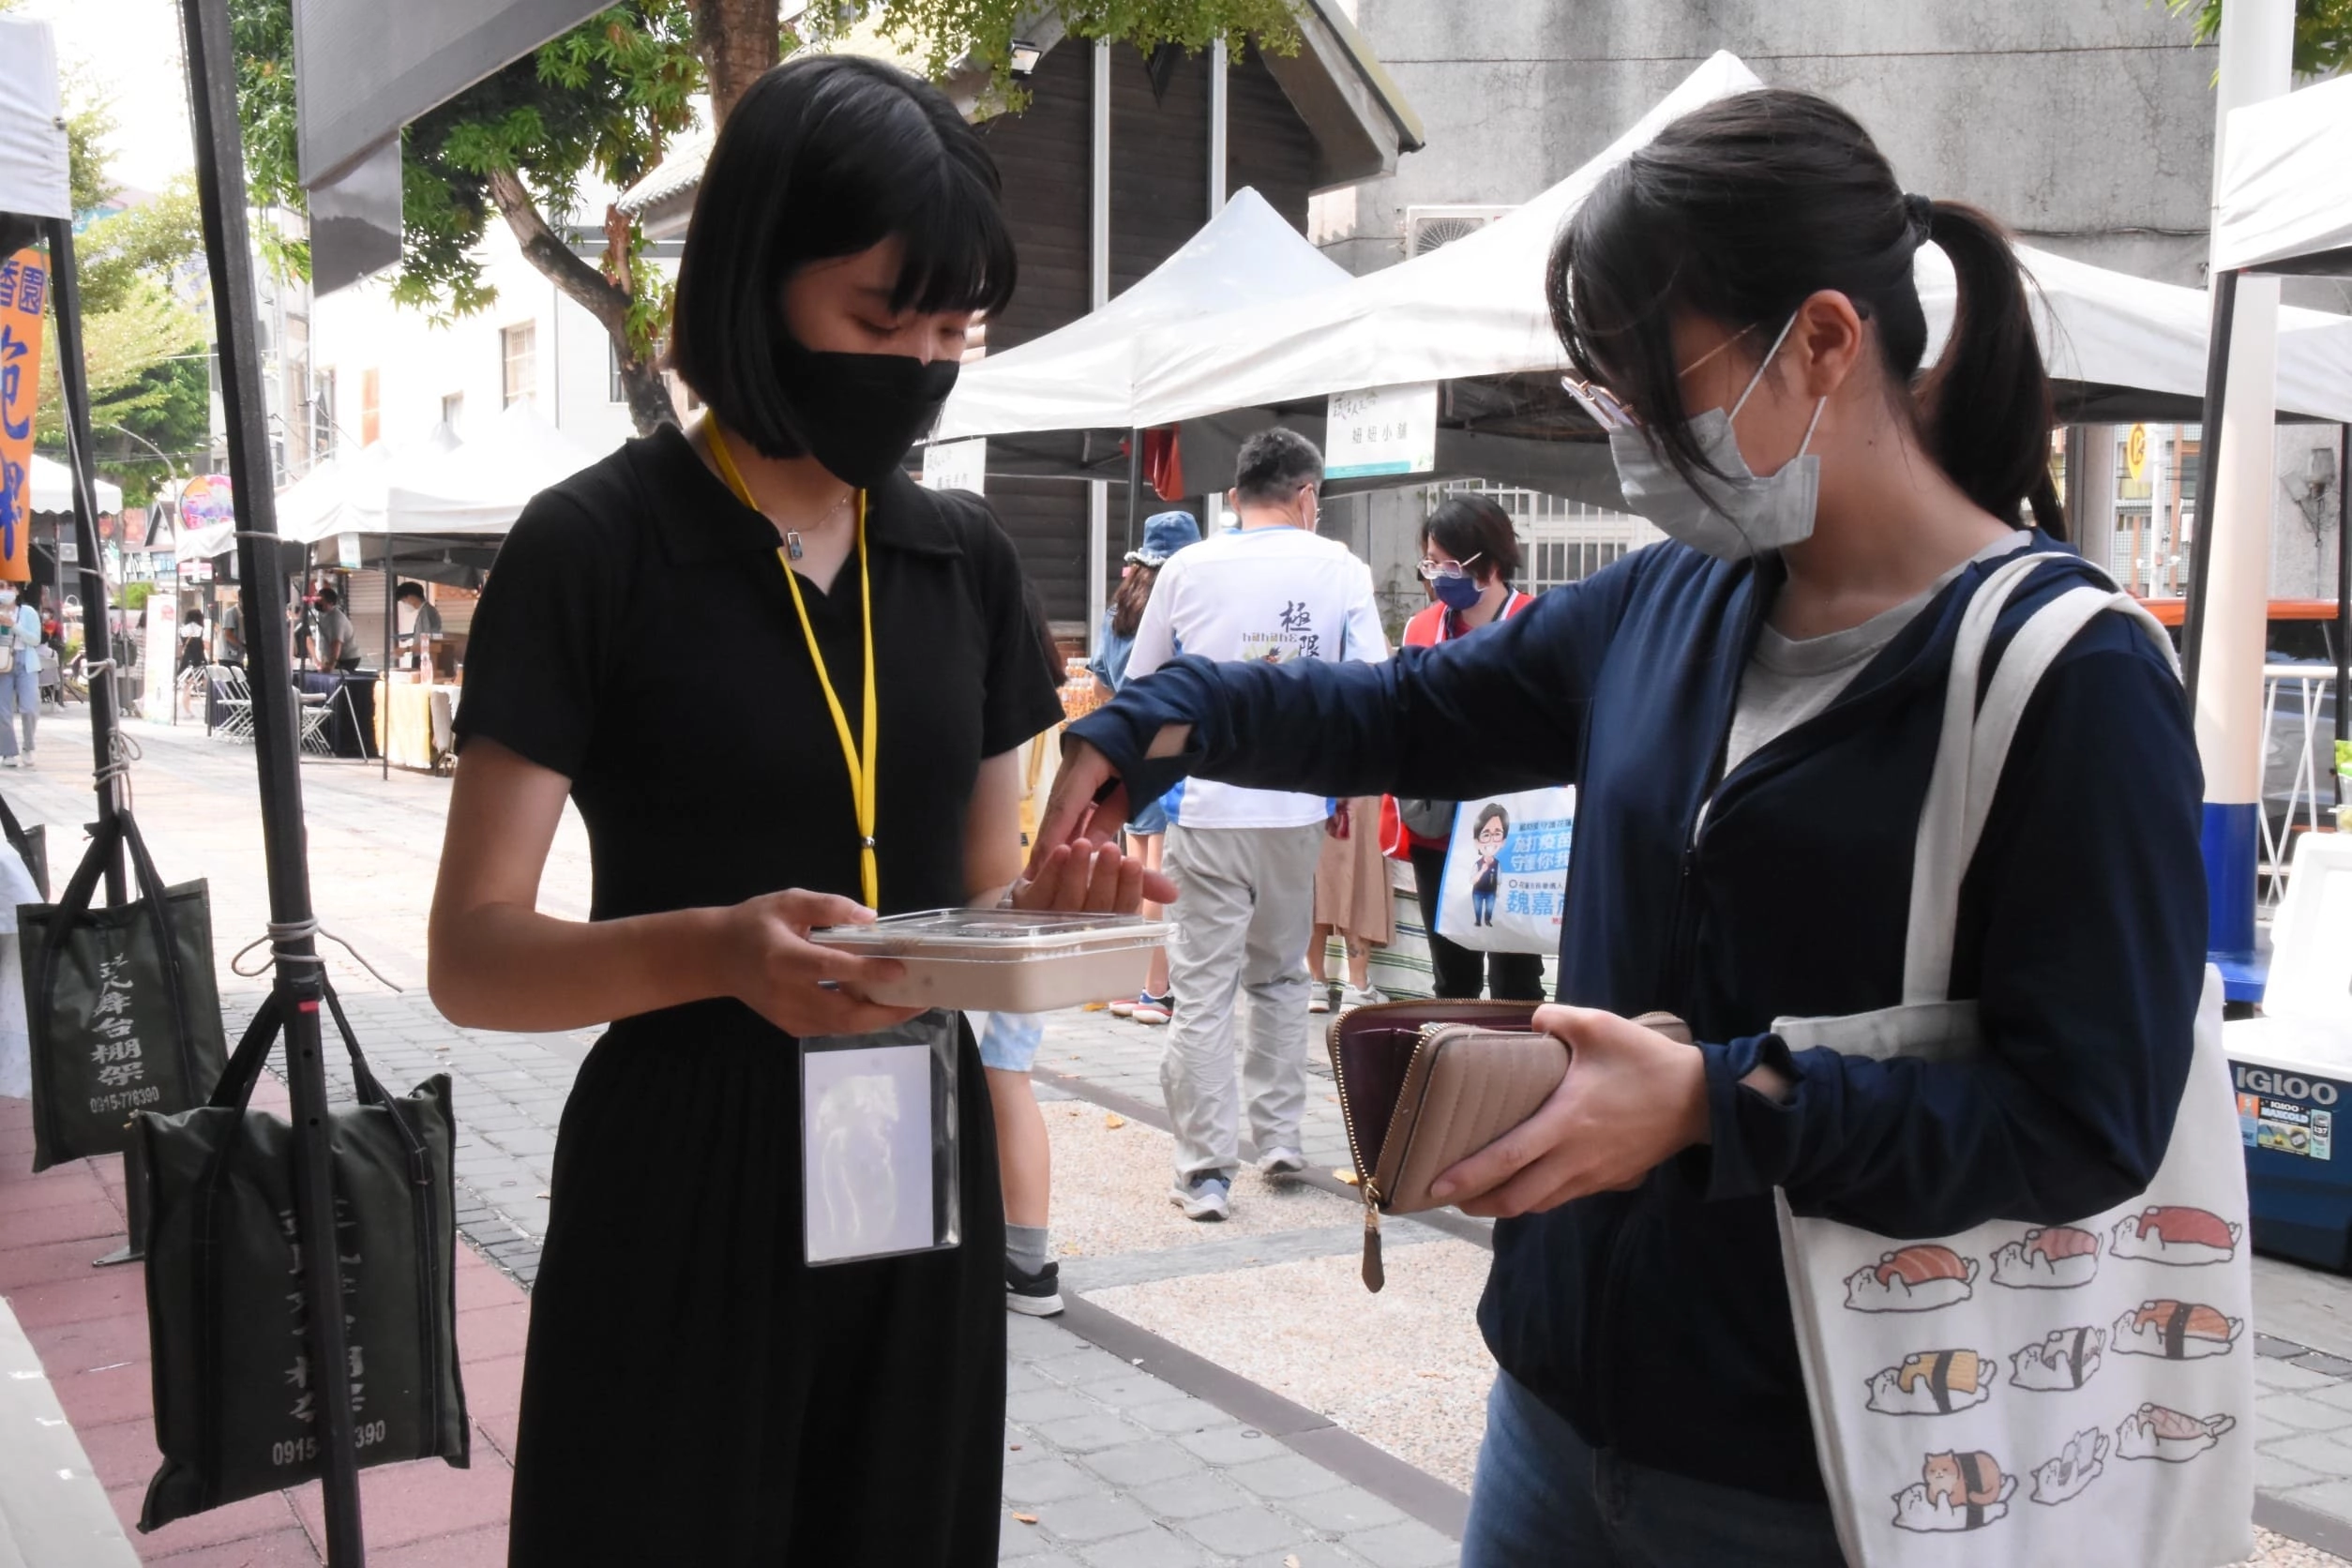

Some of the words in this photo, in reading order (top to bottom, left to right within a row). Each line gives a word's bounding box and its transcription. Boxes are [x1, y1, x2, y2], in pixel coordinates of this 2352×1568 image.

[1279, 600, 1319, 657] 極限
[89, 1085, 160, 1114] 0915-778390
[2236, 1066, 2338, 1106] IGLOO
[2269, 1101, 2299, 1112] IGLOO
